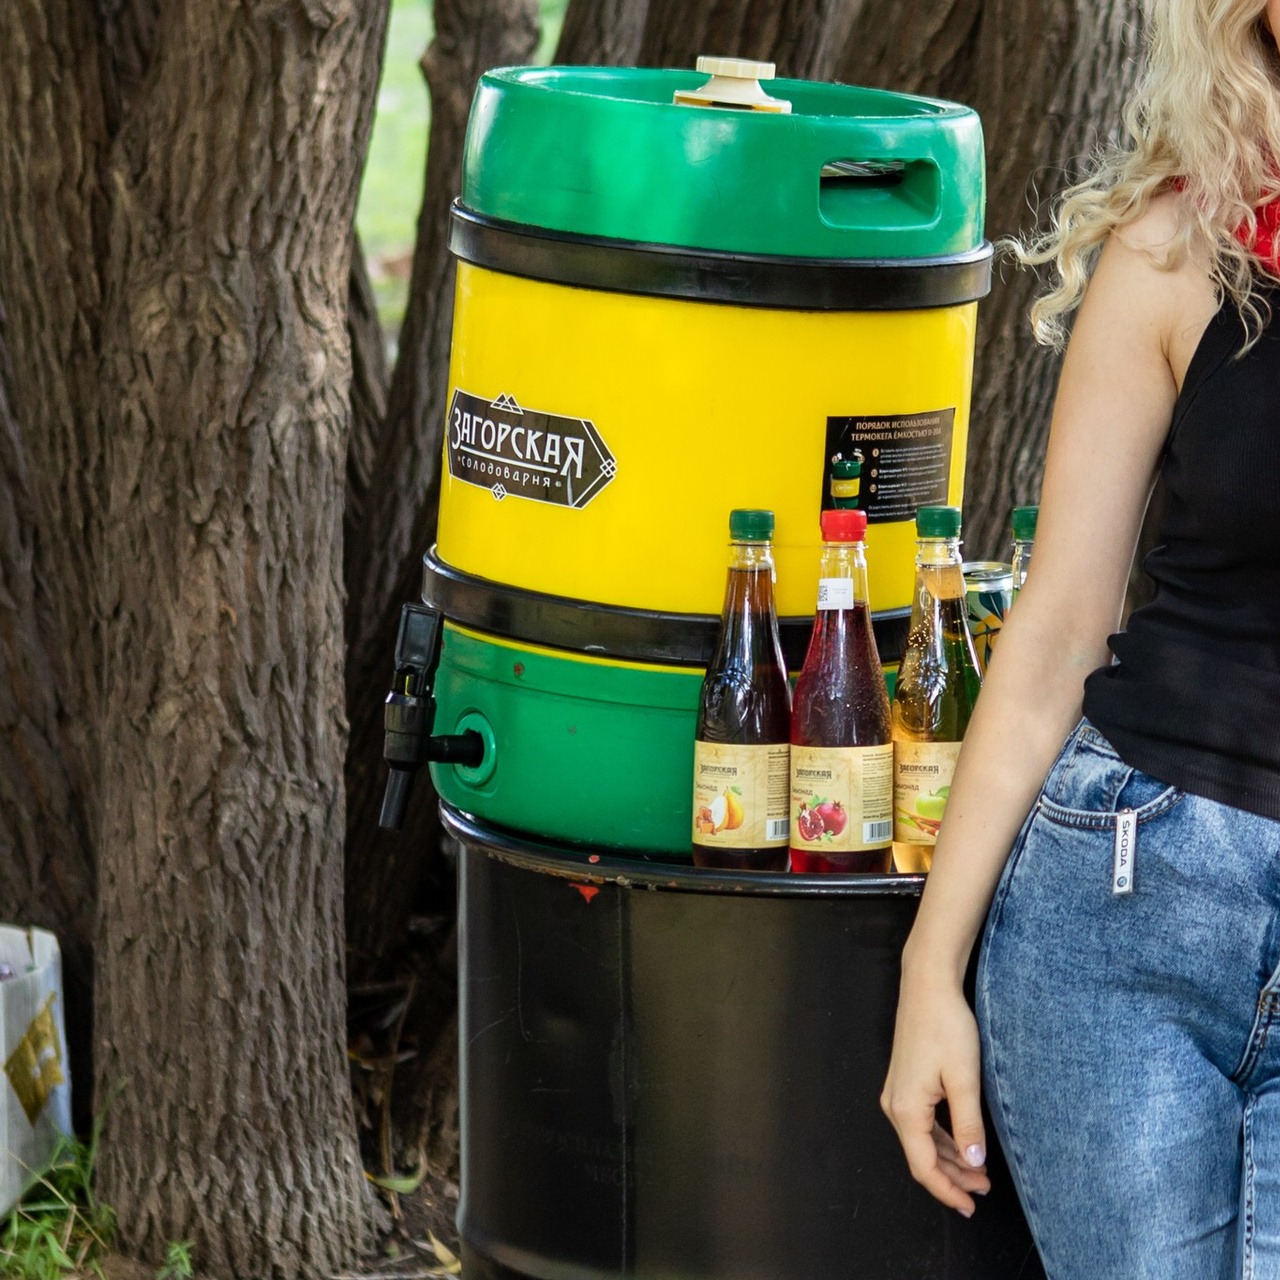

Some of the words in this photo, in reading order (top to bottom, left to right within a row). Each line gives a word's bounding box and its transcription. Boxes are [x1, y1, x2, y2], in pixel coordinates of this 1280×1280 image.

[856, 421, 891, 430] ПОРЯДОК
[451, 407, 585, 479] ЗАГОРСКАЯ
[461, 456, 551, 487] солодоварня
